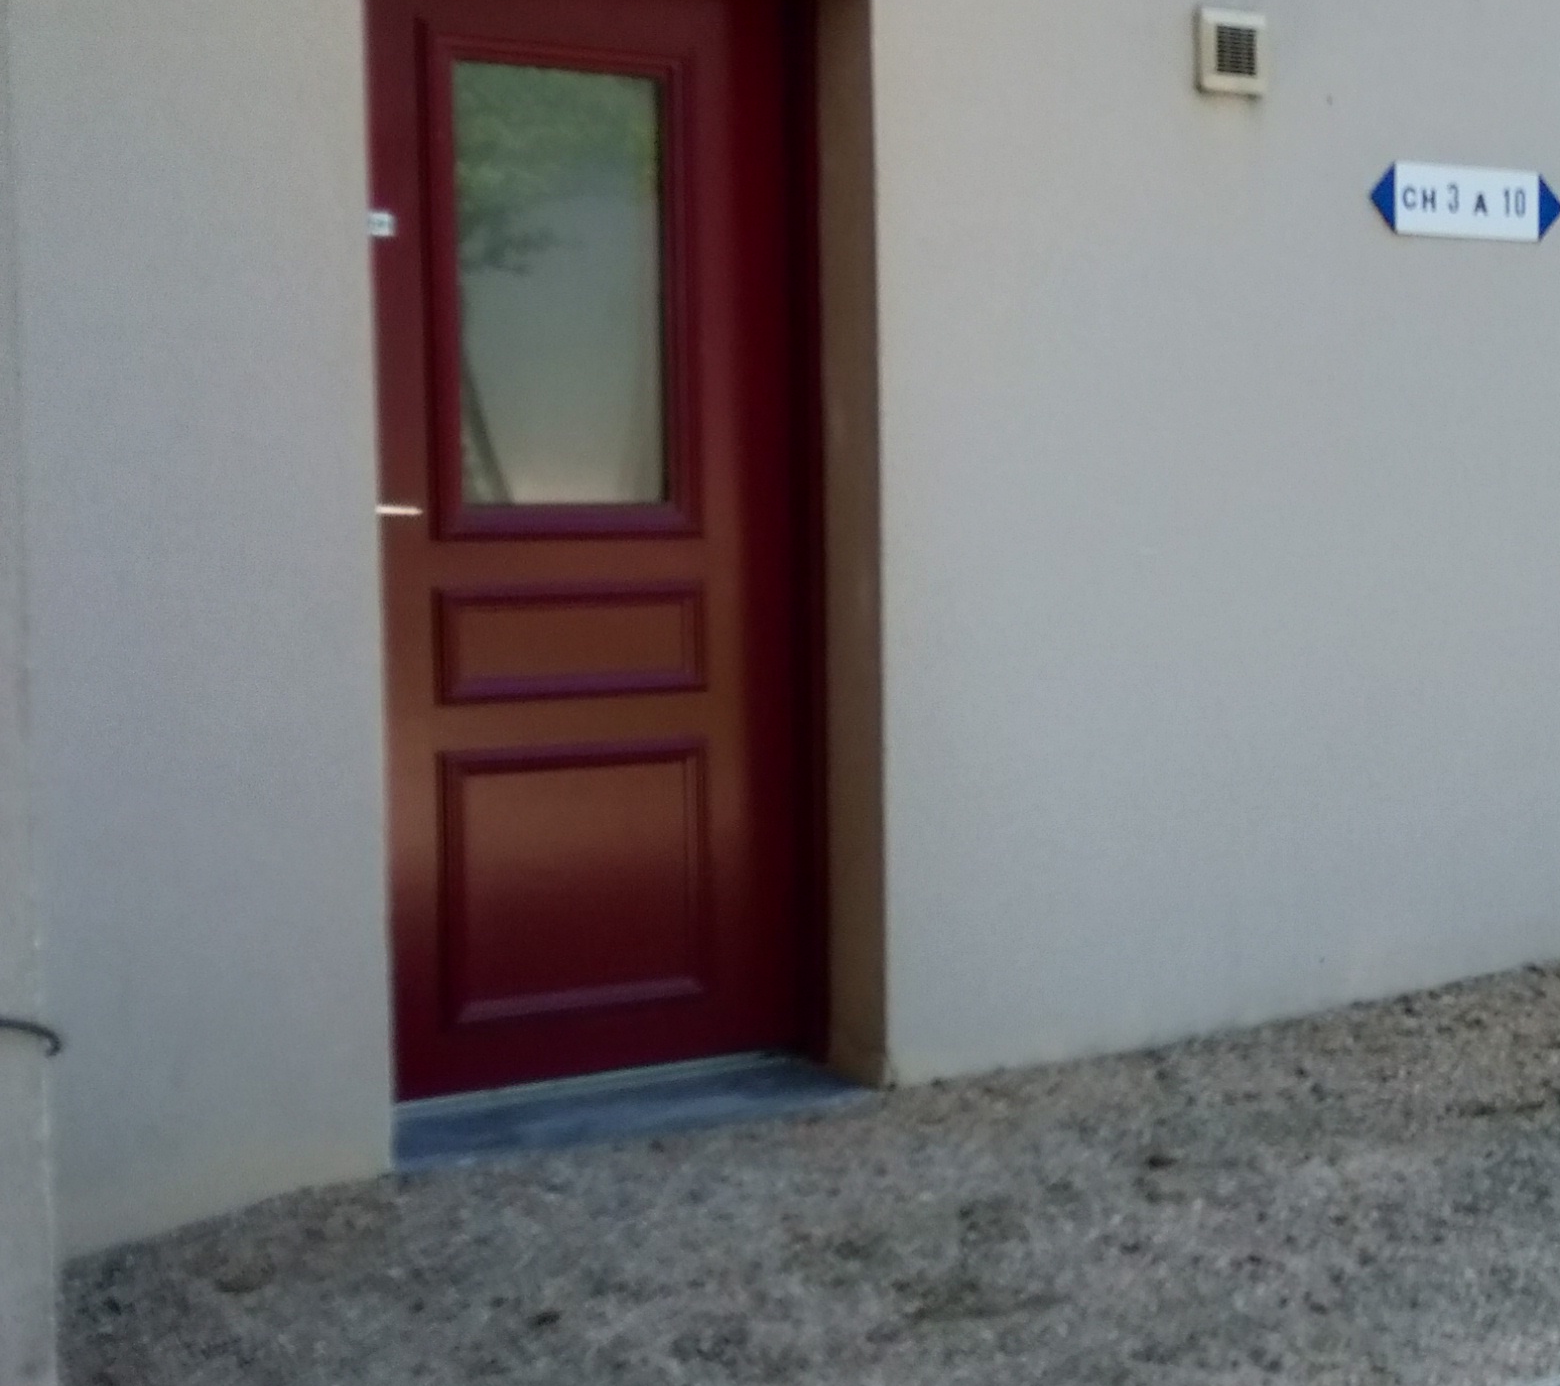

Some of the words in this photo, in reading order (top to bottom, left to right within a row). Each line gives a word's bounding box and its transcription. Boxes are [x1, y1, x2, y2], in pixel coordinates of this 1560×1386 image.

[1402, 186, 1437, 213] CH
[1447, 183, 1460, 213] 3
[1474, 193, 1488, 216] A
[1503, 187, 1527, 217] 10
